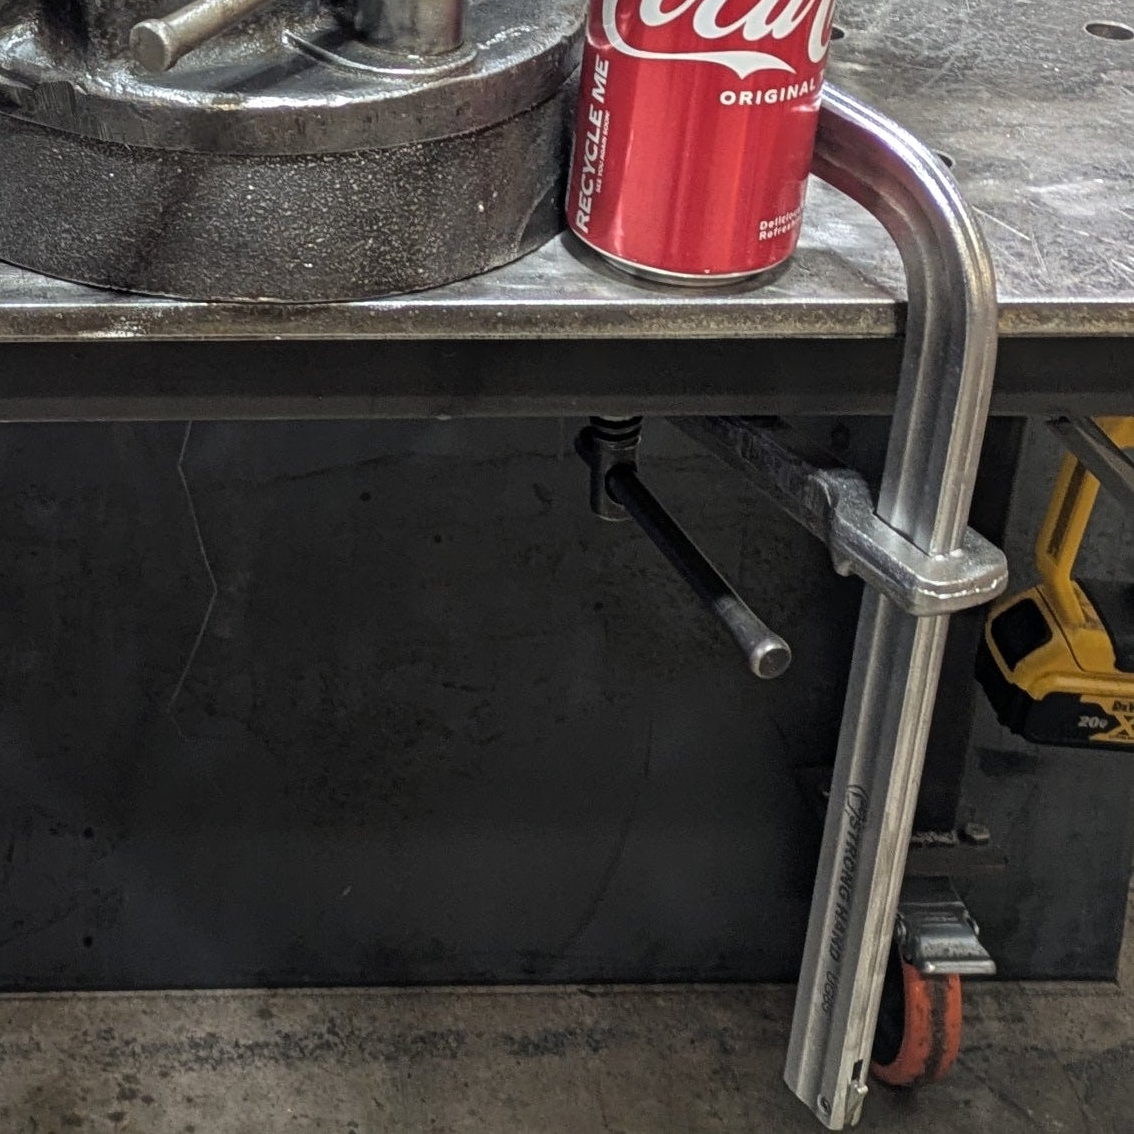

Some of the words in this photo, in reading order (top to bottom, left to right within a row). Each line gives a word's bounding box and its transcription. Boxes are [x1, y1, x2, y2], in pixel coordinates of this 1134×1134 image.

[720, 78, 816, 106] ORIGINAL
[575, 103, 603, 234] RECYCLE
[591, 54, 610, 104] ME
[838, 814, 865, 902] STRONG
[829, 903, 850, 963] HAND
